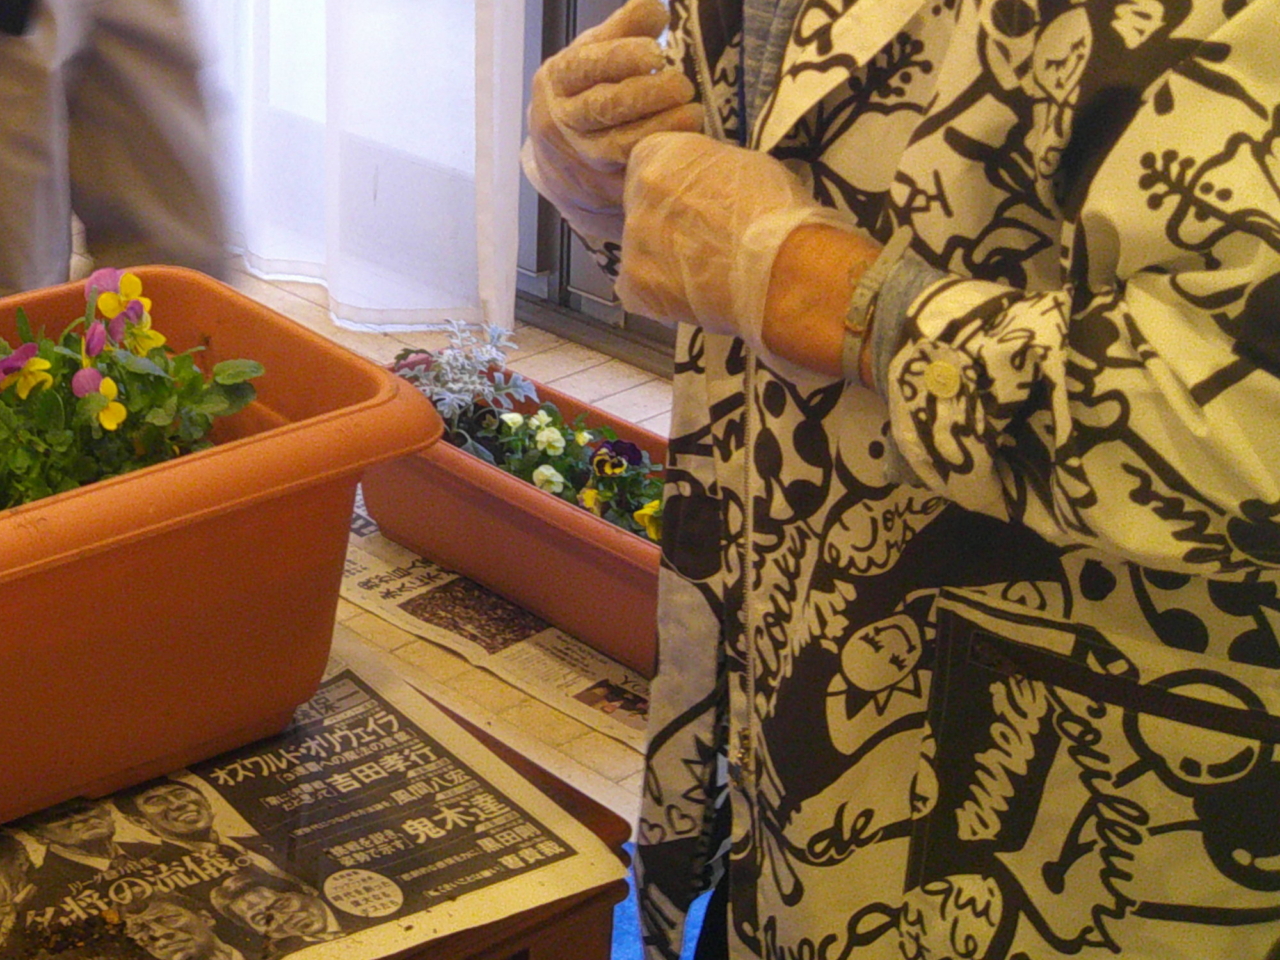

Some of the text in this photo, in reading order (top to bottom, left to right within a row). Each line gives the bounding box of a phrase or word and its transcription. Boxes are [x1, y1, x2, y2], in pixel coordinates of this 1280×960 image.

[209, 709, 401, 787] オズワルド・オリヴェイラ
[325, 739, 439, 794] 吉田孝行
[389, 768, 471, 806] 風間八宏
[401, 791, 511, 844] 鬼木達
[476, 821, 543, 854] 黒田剛
